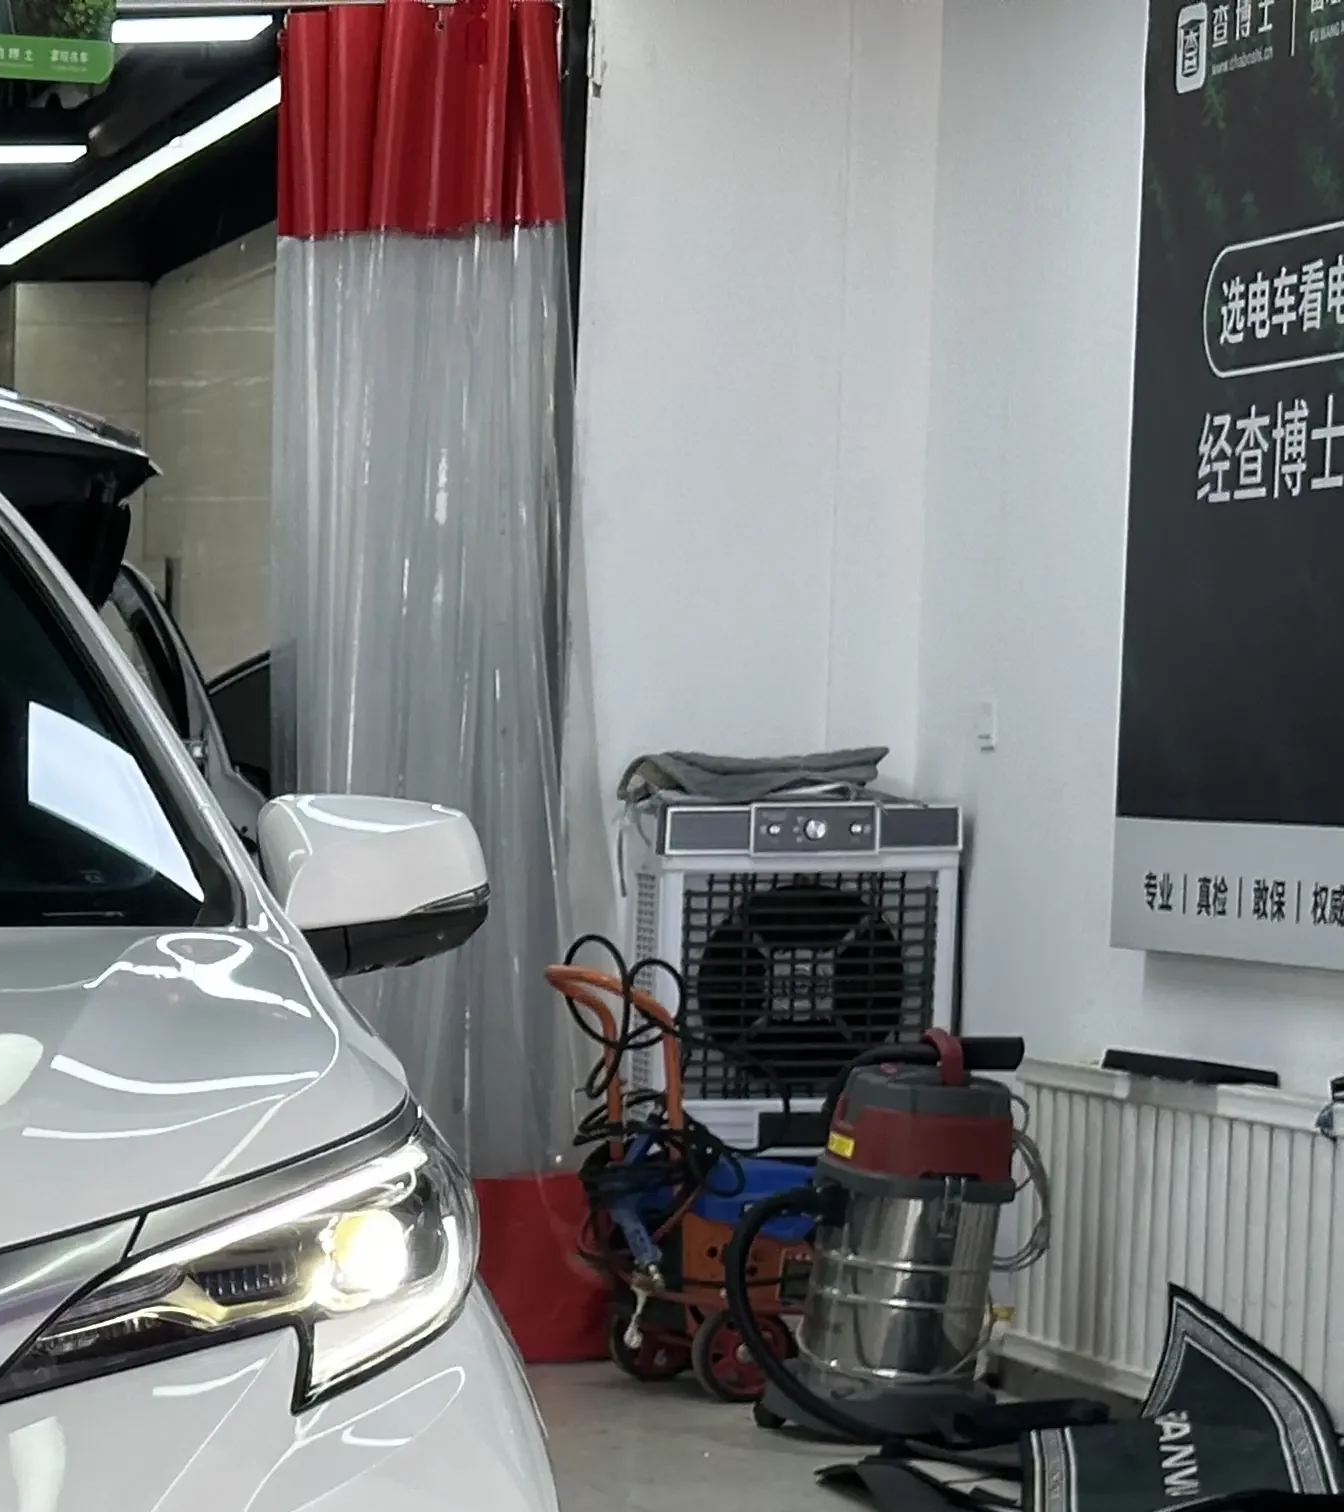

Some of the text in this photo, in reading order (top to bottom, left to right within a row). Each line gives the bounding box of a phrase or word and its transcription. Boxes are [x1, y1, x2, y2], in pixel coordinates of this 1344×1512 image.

[1196, 393, 1344, 503] 经查博士
[1143, 869, 1174, 912] 专业
[1196, 875, 1229, 917] 真检
[1252, 878, 1286, 922] 敢保
